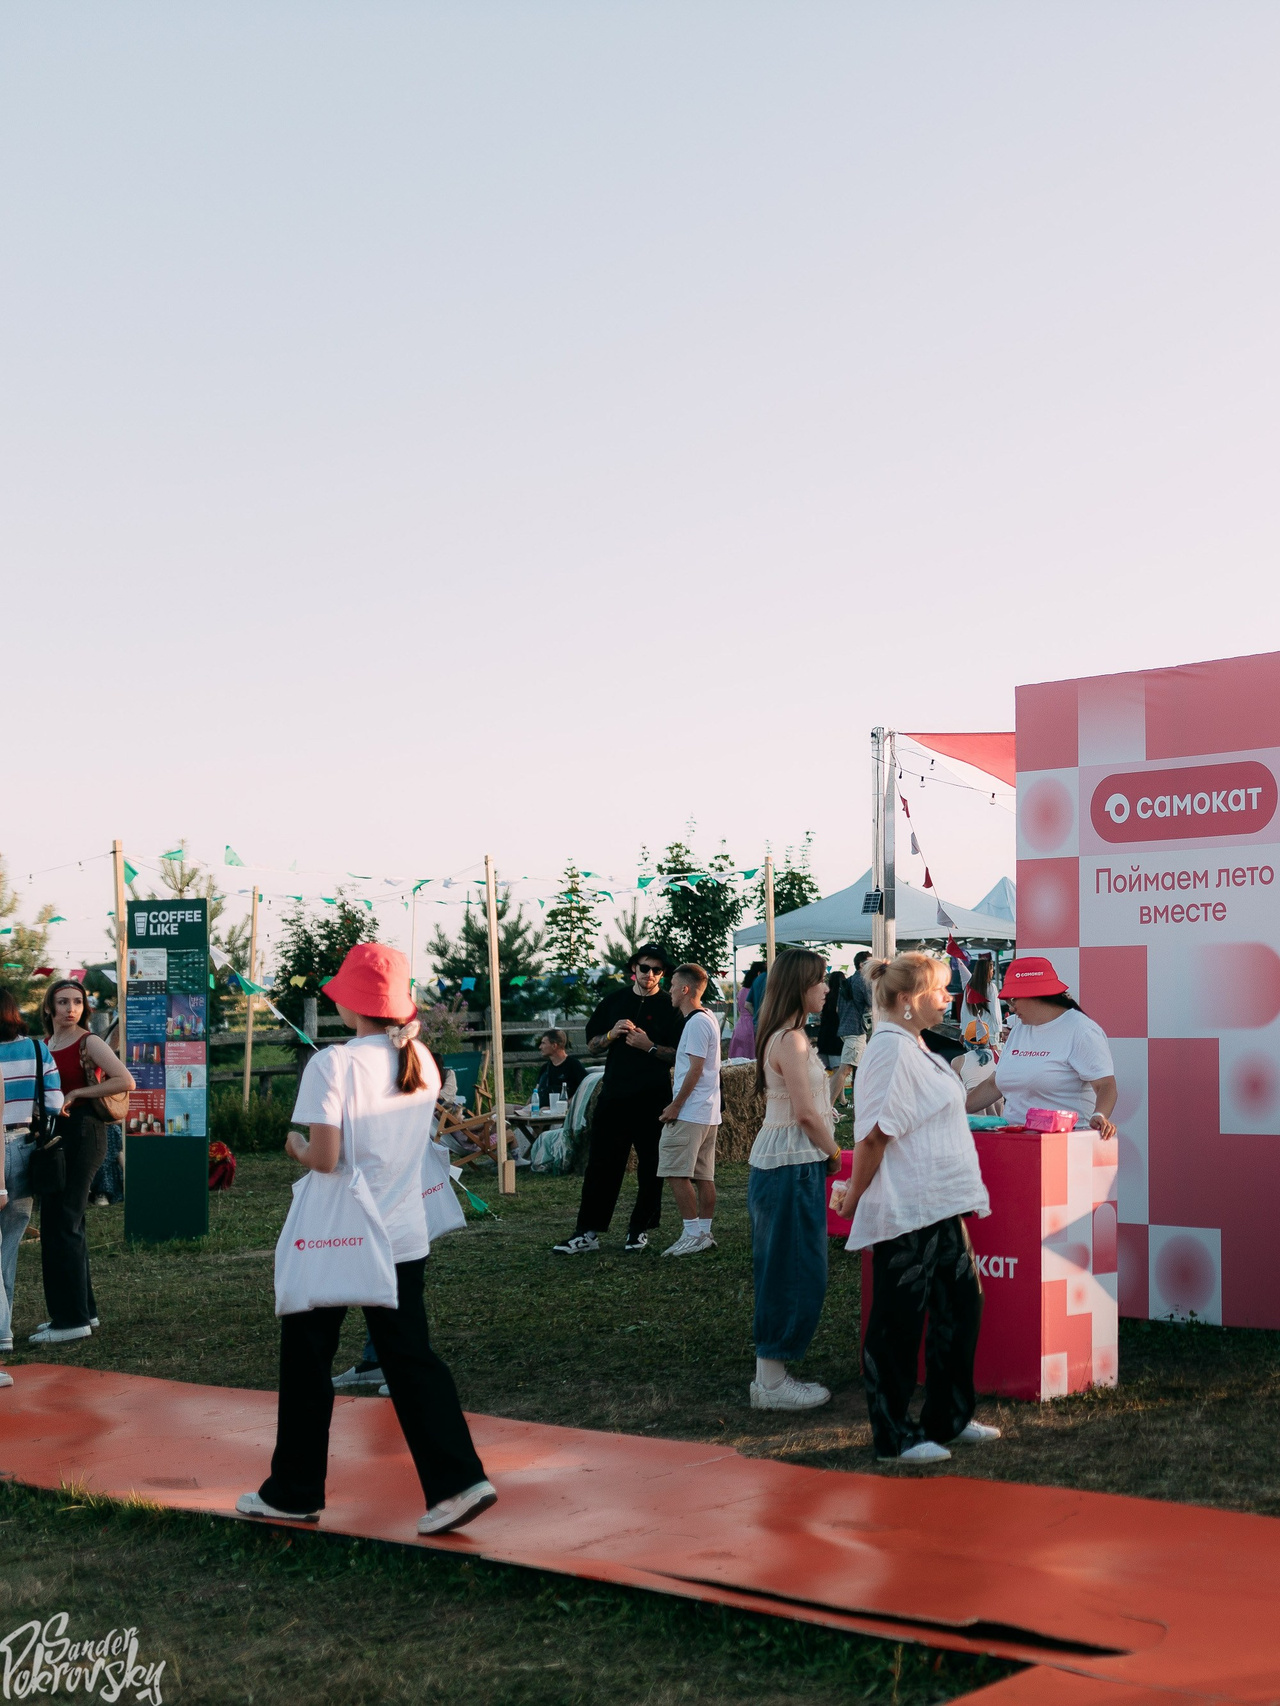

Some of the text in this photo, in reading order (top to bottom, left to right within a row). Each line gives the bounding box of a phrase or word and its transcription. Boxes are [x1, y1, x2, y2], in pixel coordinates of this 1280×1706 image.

[1136, 787, 1262, 819] самокат
[1095, 864, 1275, 894] Поймаем лето
[149, 910, 202, 923] COFFEE
[1139, 902, 1227, 925] вместе
[149, 923, 179, 936] LIKE
[1018, 1050, 1051, 1058] самокат
[421, 1182, 444, 1199] мокат
[308, 1237, 364, 1249] самокат
